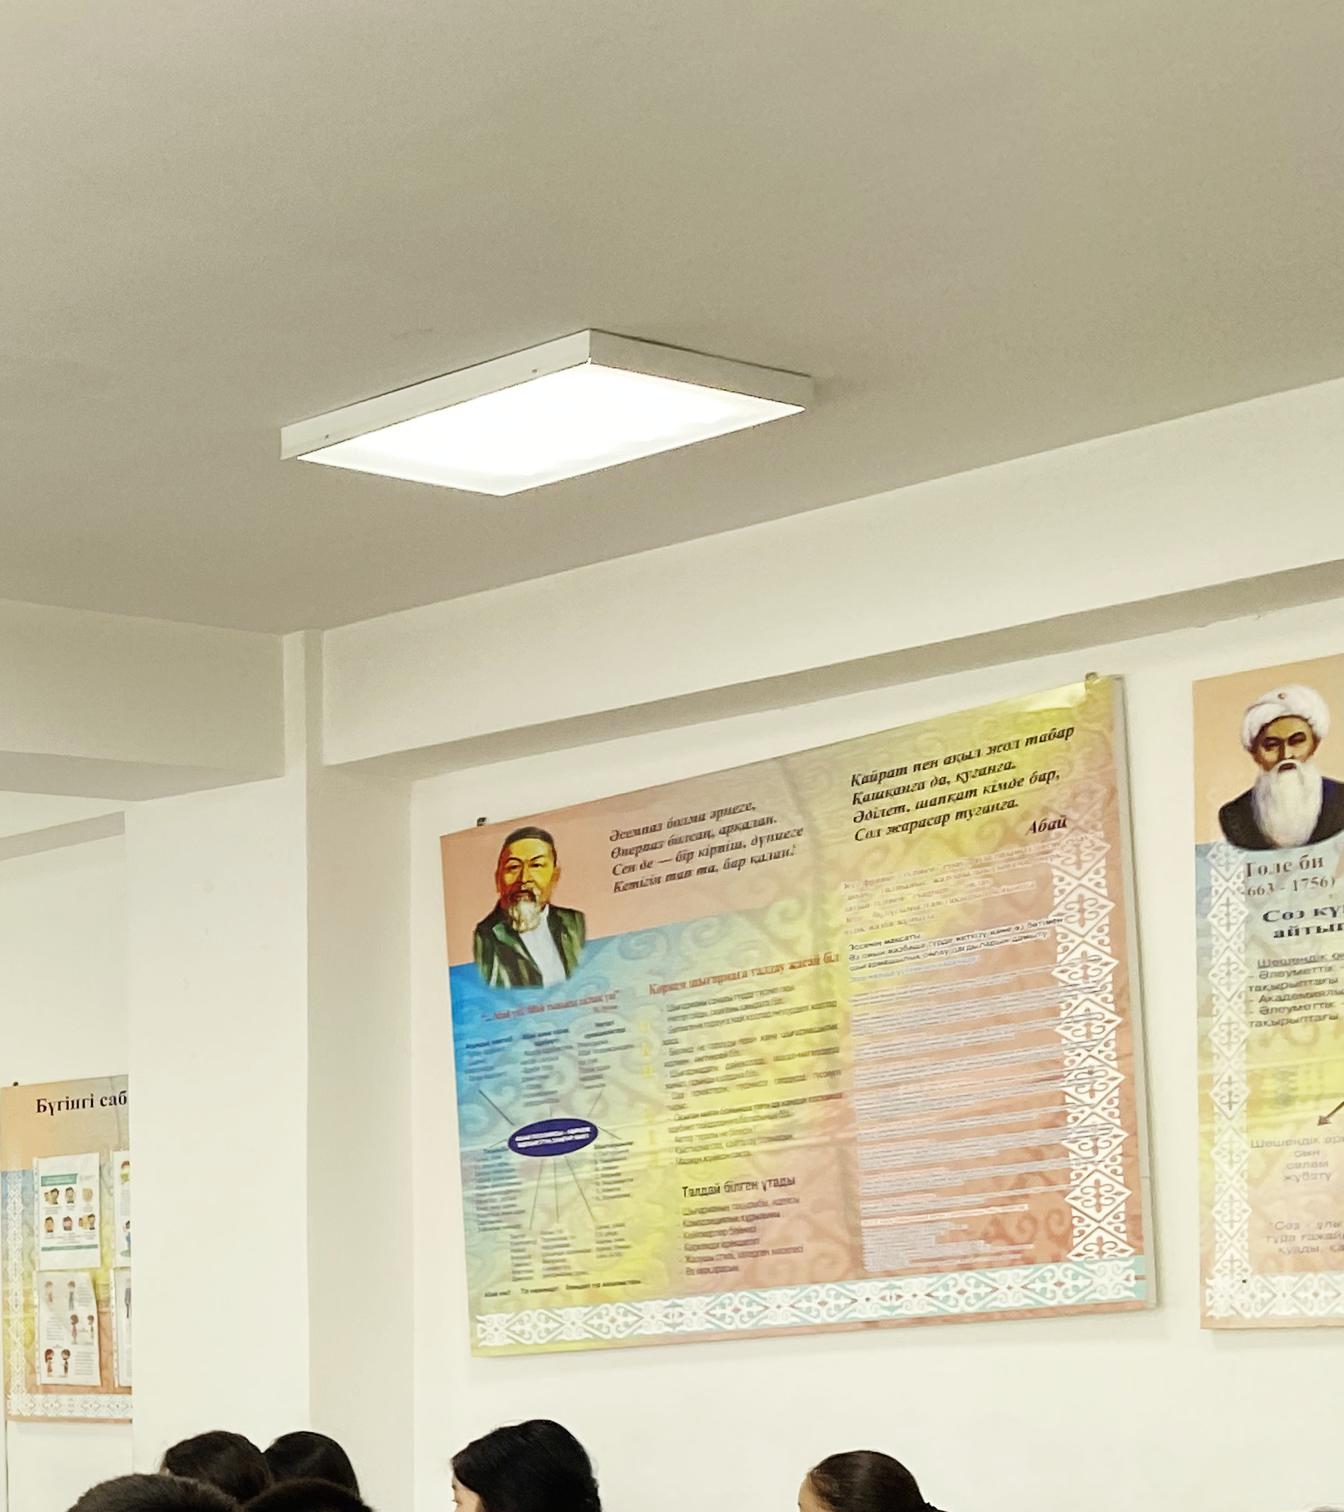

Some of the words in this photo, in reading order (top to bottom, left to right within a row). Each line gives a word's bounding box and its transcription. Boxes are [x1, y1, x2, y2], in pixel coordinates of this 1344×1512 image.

[912, 757, 939, 773] пен
[986, 740, 1020, 756] жол
[1024, 725, 1075, 747] табар
[982, 776, 1025, 795] кімде
[854, 827, 881, 841] Сол
[885, 813, 950, 835] жарасар
[1026, 815, 1068, 836] Абай
[612, 863, 635, 876] Сен
[639, 858, 654, 870] де
[675, 850, 694, 864] бір
[665, 868, 692, 883] тап
[722, 856, 746, 871] бар
[1299, 854, 1323, 870] би
[1313, 904, 1344, 918] кү
[36, 1093, 94, 1116] Бүгінгі
